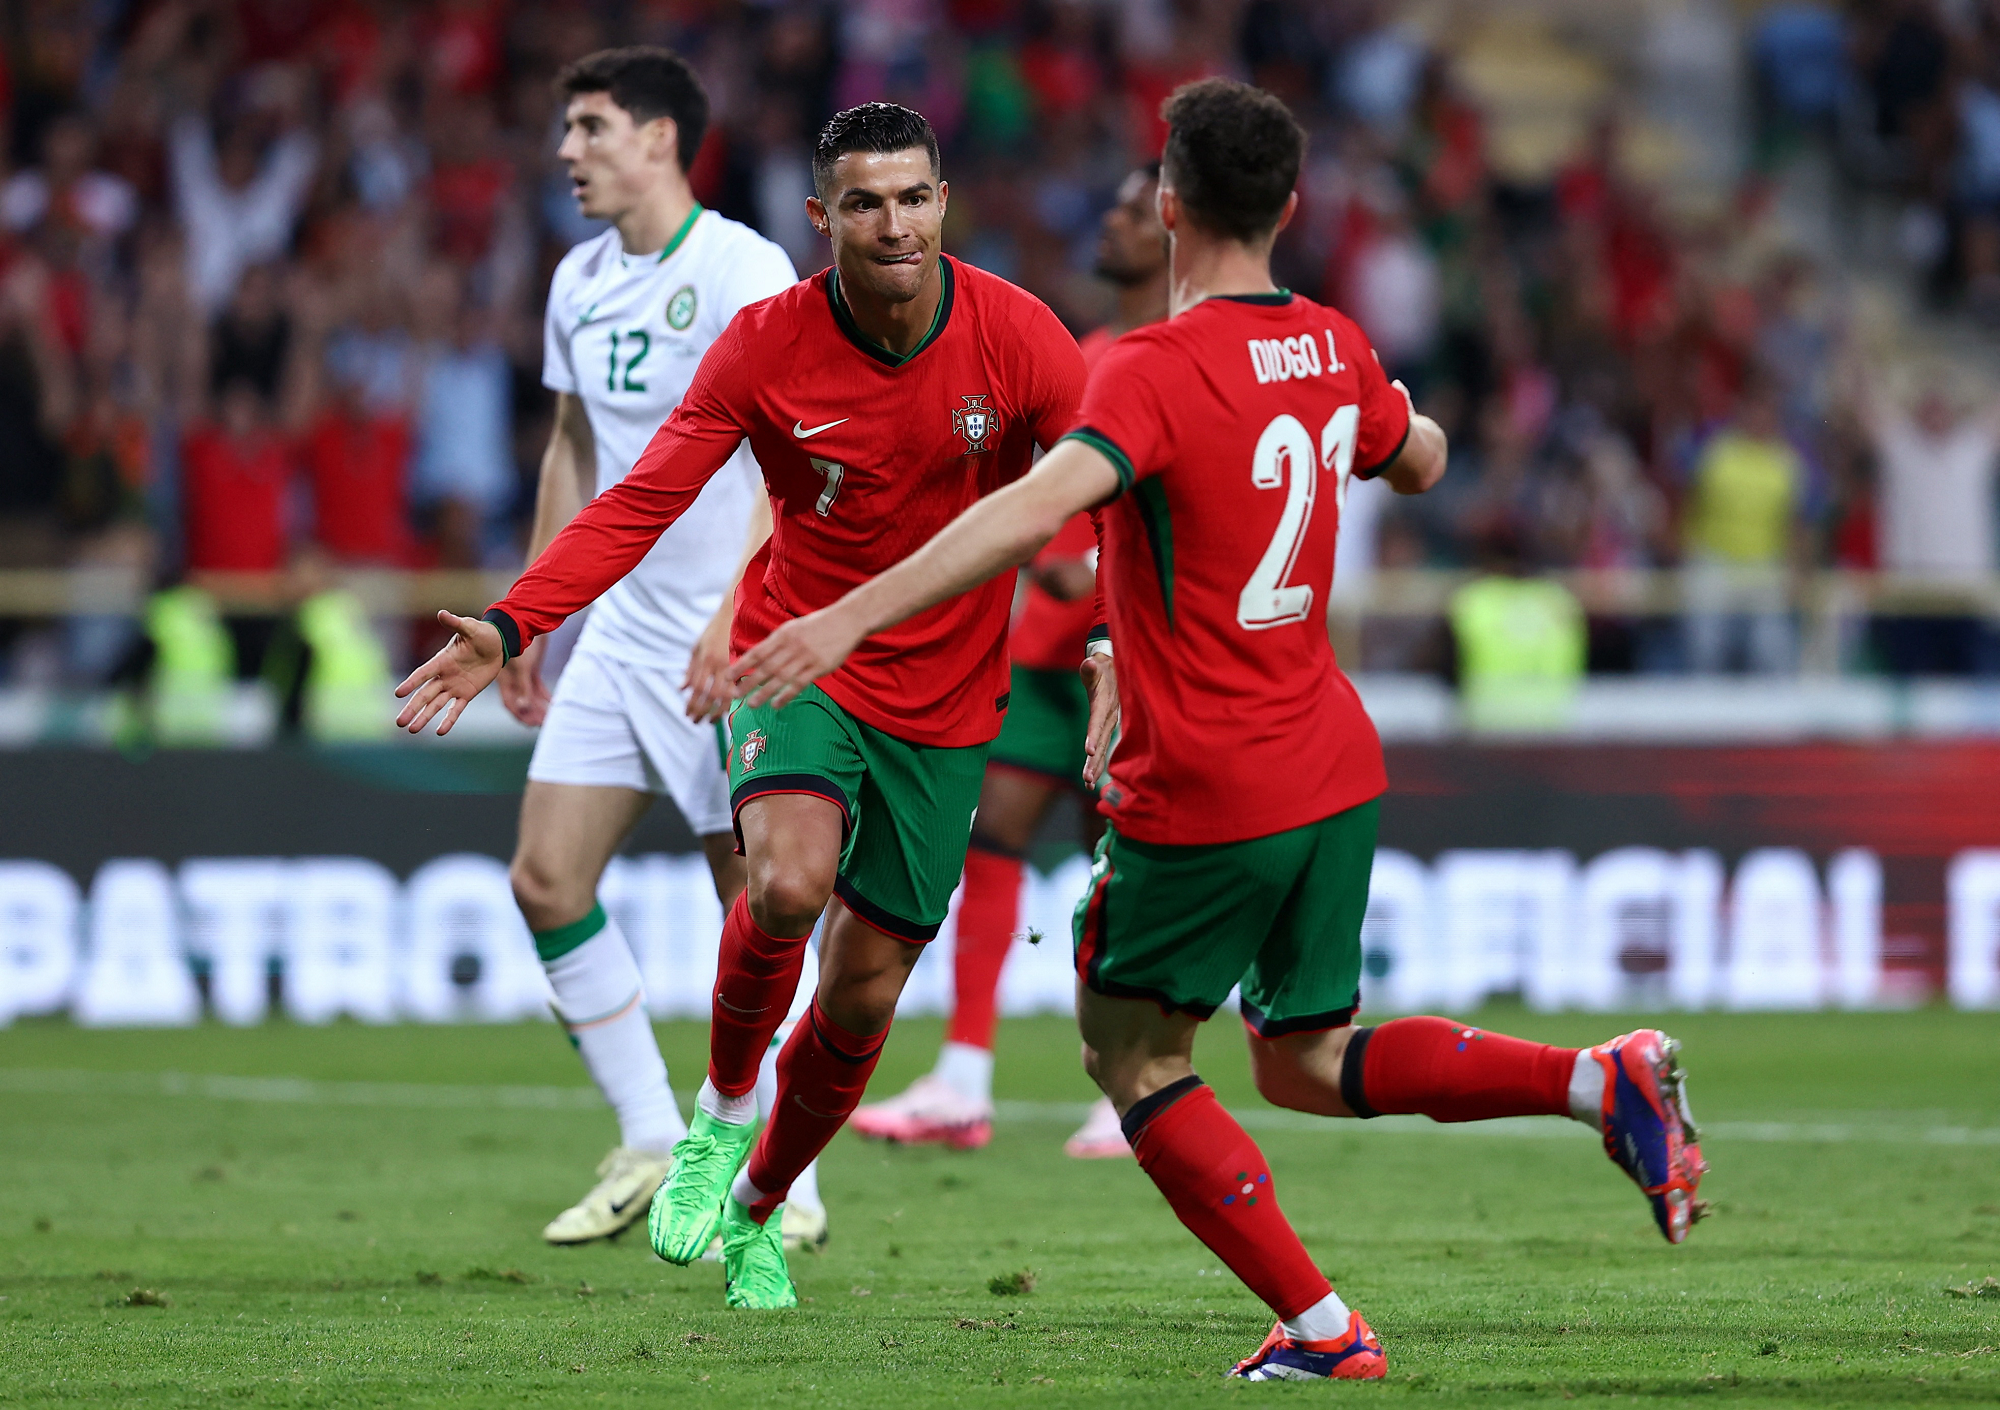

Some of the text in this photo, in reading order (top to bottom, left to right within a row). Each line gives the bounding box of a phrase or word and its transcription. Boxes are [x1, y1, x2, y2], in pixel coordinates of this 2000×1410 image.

[607, 329, 650, 392] 12
[1247, 328, 1346, 384] DIOGO J.
[809, 456, 845, 518] 7
[1237, 403, 1360, 631] 21
